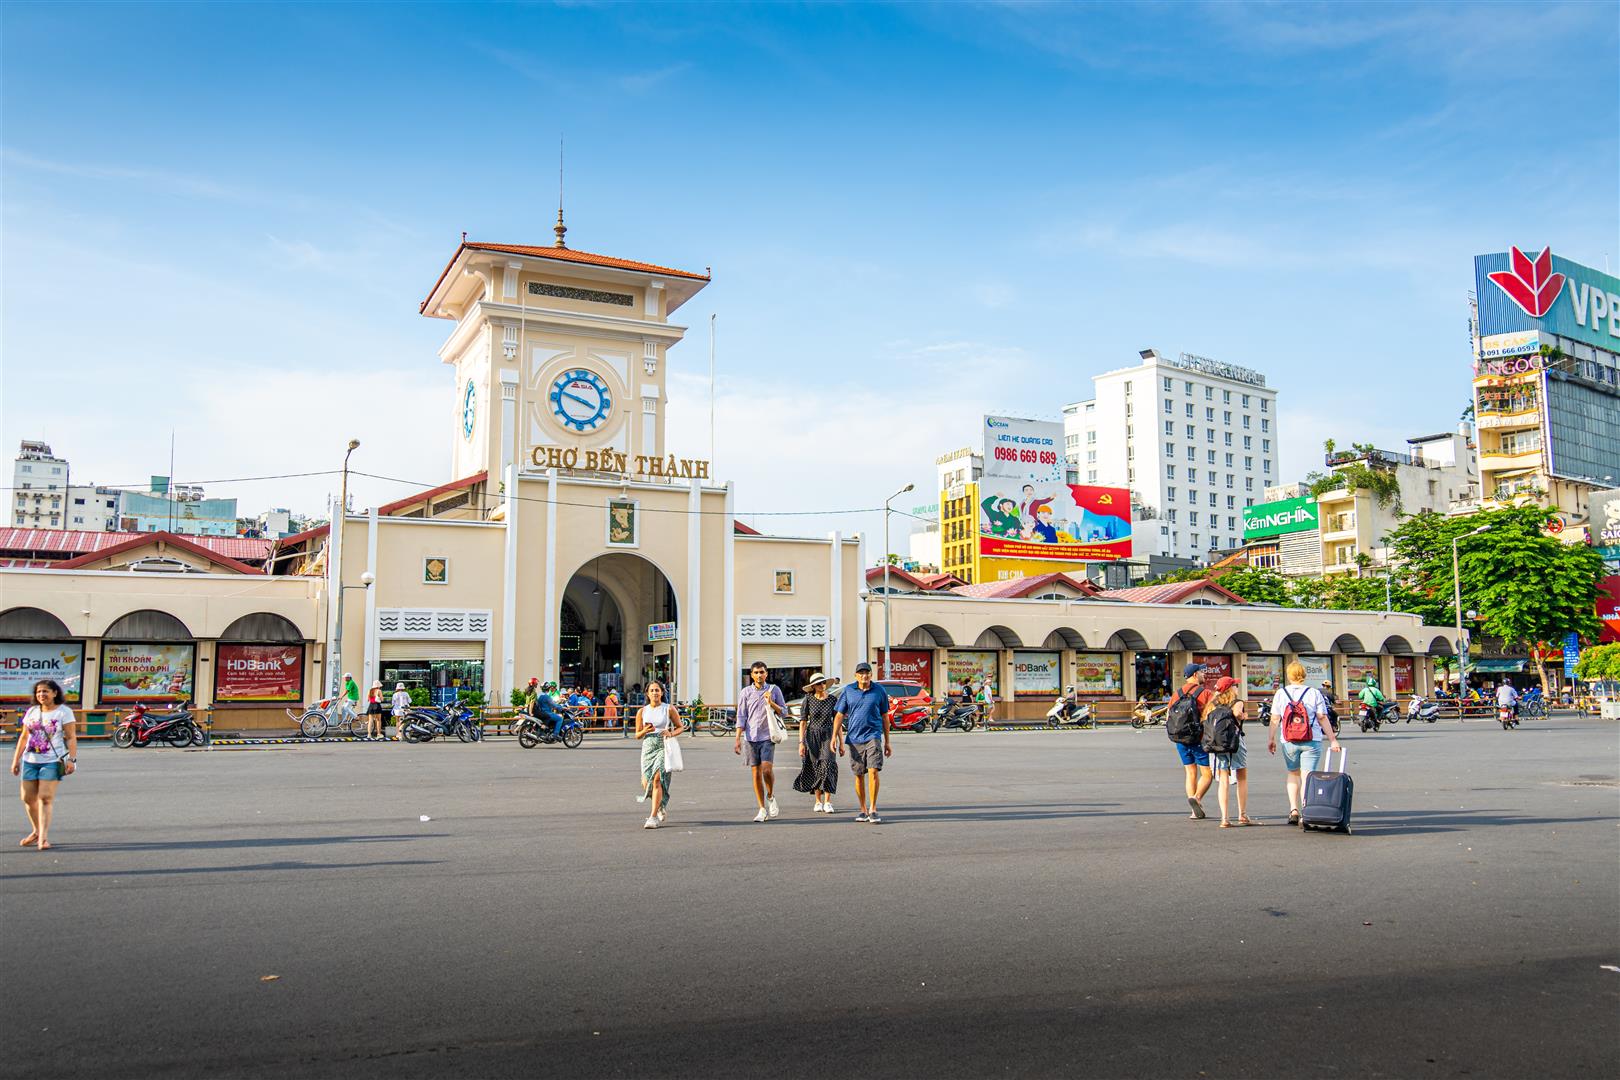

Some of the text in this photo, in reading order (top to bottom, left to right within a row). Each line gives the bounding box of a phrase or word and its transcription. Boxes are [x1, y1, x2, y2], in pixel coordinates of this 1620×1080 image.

[531, 446, 709, 479] CHỢ BẾN THÀNH
[994, 446, 1056, 465] 0986 669 689
[227, 659, 281, 671] HDBank
[1015, 664, 1048, 672] HDBank
